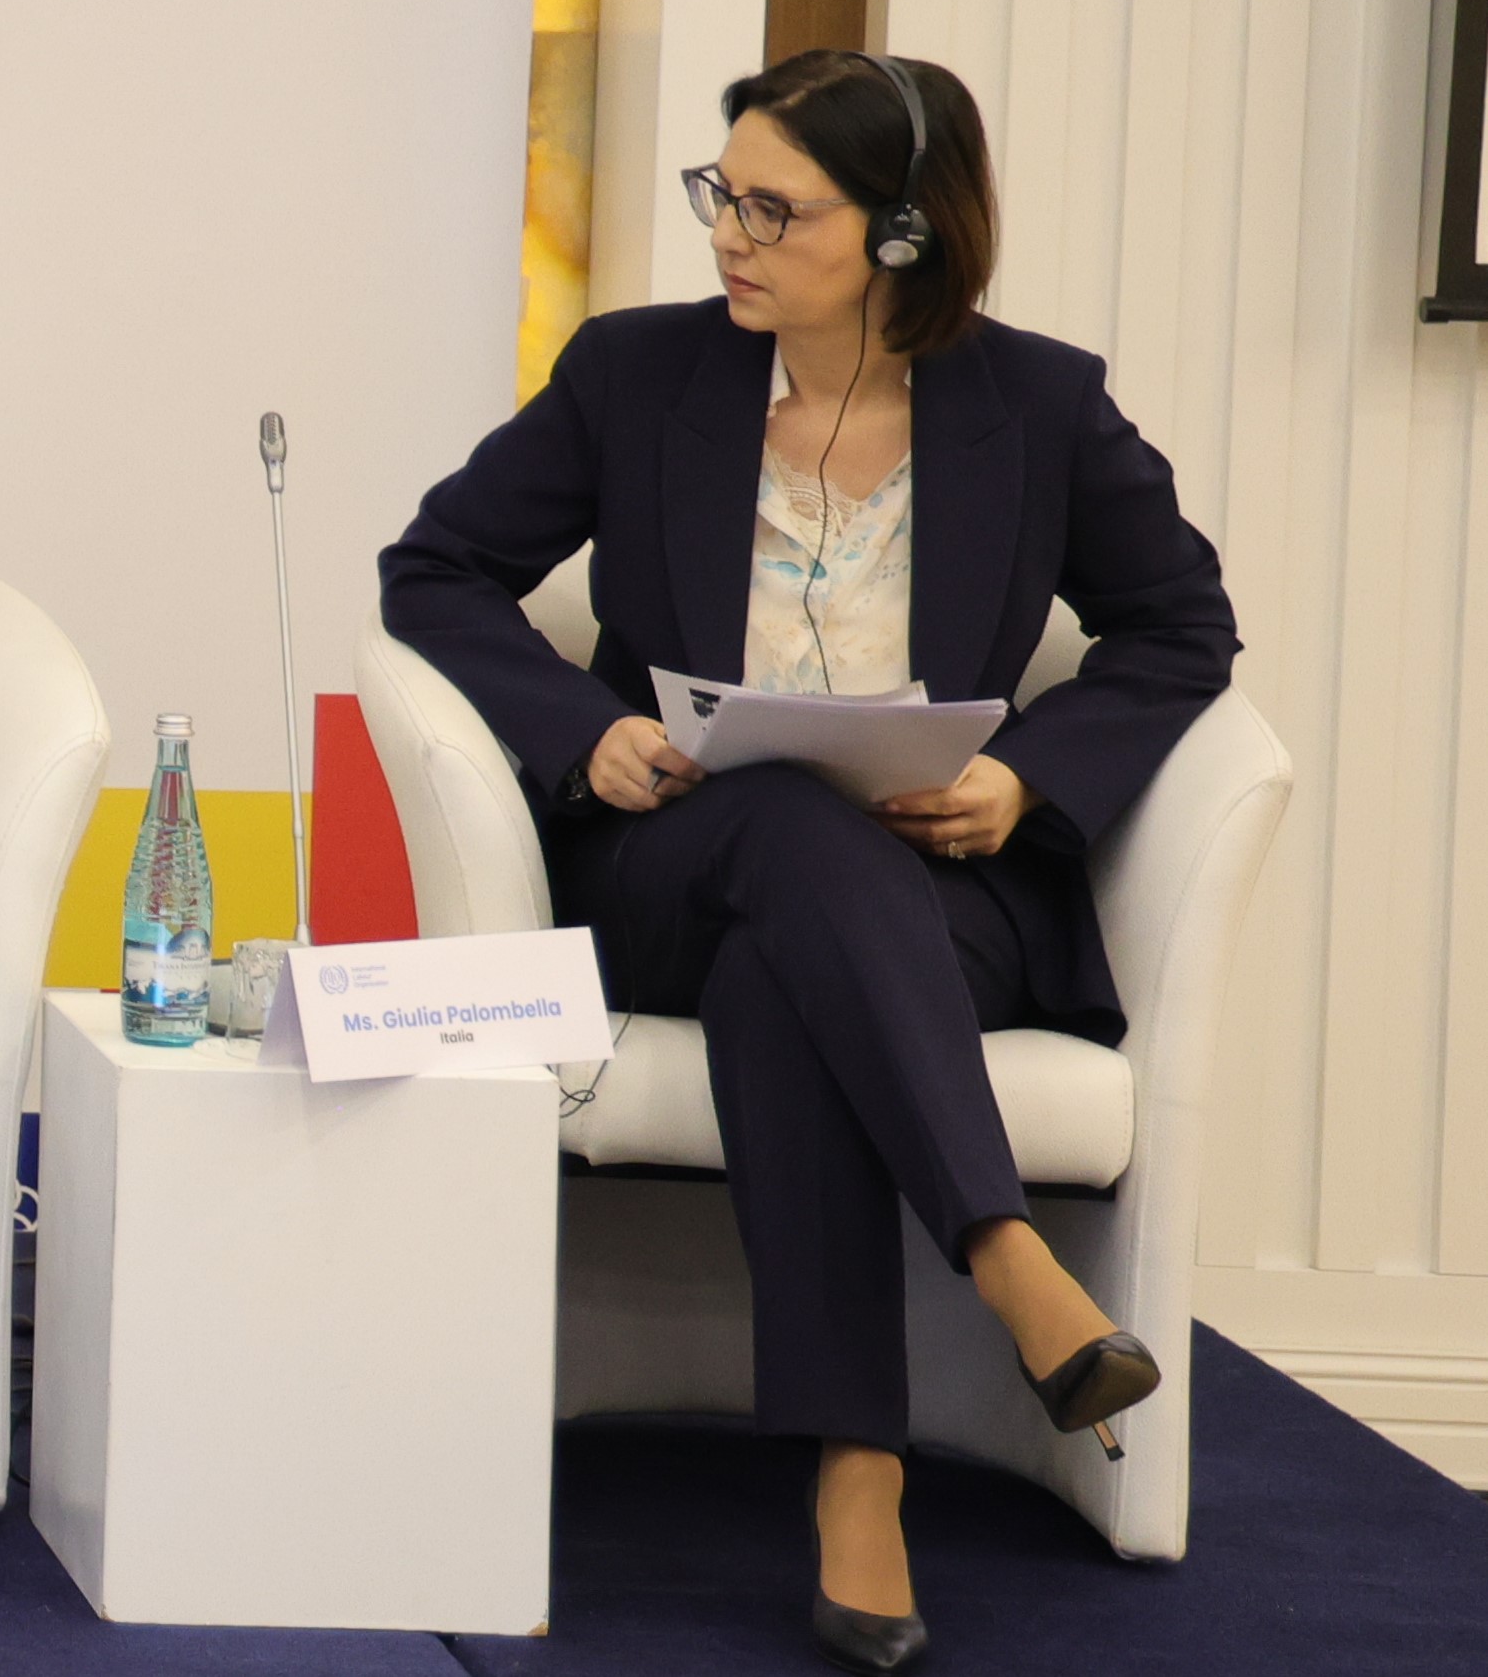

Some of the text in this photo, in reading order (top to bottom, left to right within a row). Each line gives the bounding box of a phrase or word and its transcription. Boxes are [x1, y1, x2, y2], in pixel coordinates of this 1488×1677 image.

[343, 998, 561, 1032] Ms. Giulia Palombella
[440, 1030, 474, 1043] Italia
